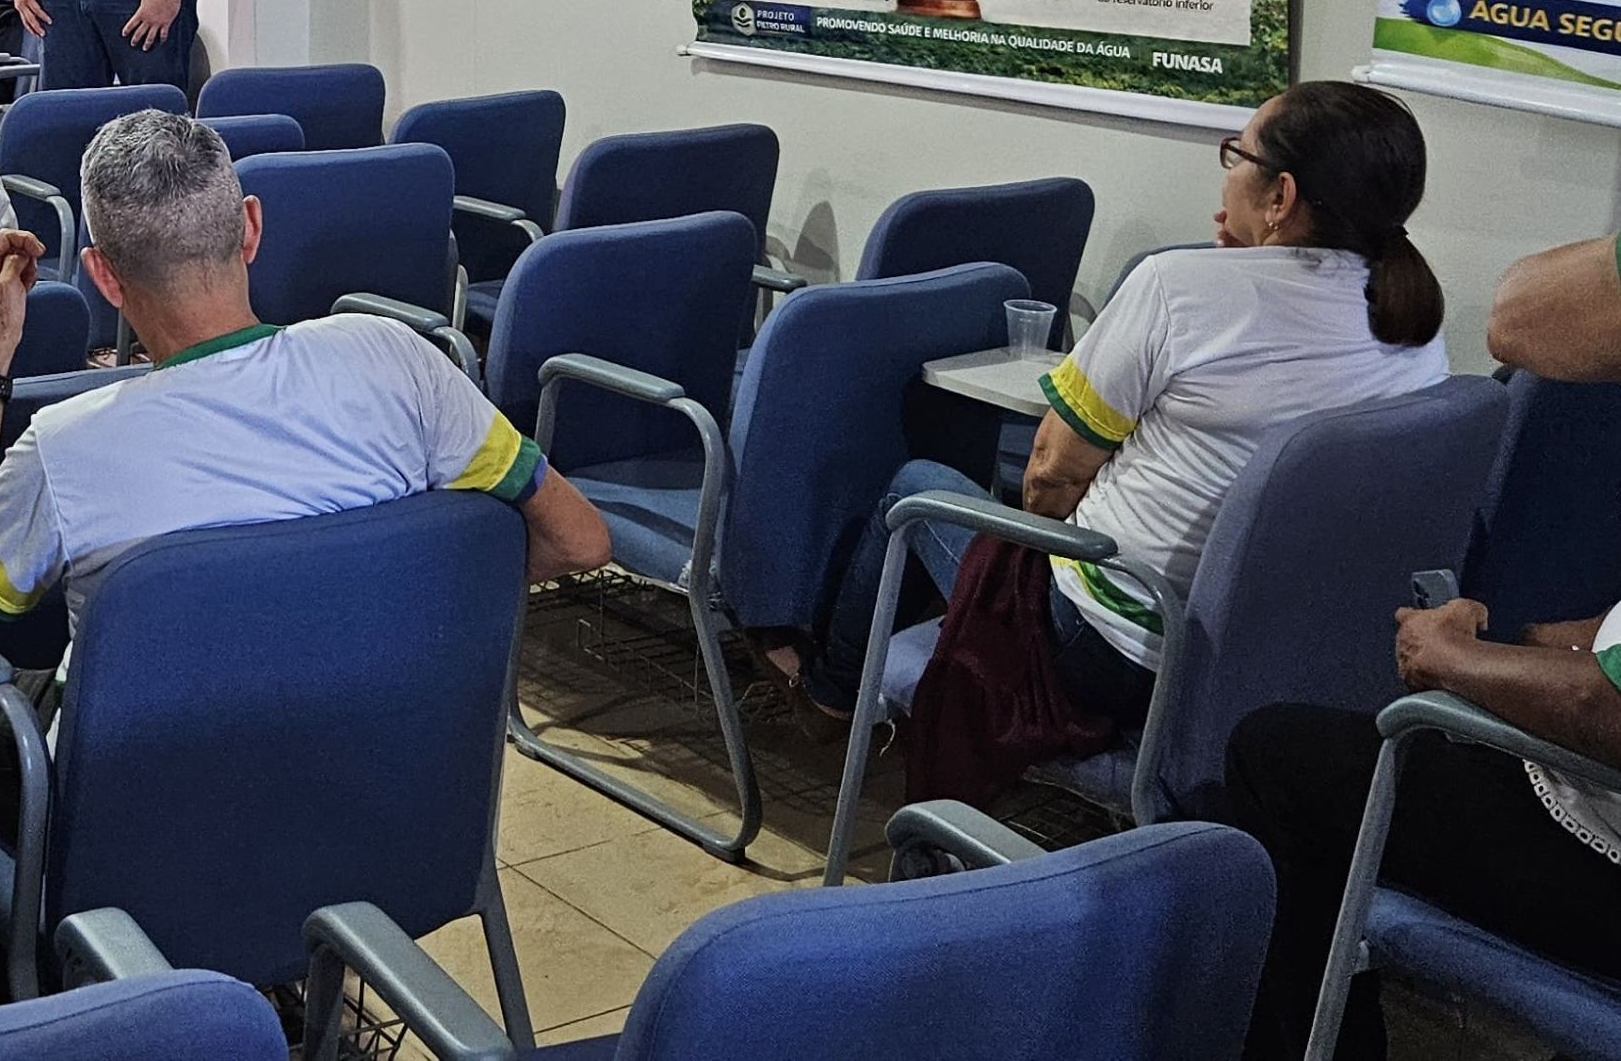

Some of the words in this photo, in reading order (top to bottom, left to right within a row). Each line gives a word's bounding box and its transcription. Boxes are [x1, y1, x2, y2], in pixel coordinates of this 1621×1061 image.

[757, 10, 794, 22] PROJETO
[780, 22, 804, 33] RURAL
[816, 17, 886, 33] PROMOVENDO
[888, 22, 922, 37] SAÚDE
[925, 27, 930, 37] E
[933, 28, 989, 44] MELHORIA
[990, 32, 1007, 45] NA
[1008, 34, 1073, 52] QUALIDADE
[1077, 42, 1093, 54] DA
[1095, 42, 1130, 58] ÁGUA
[1152, 51, 1223, 74] FUNASA
